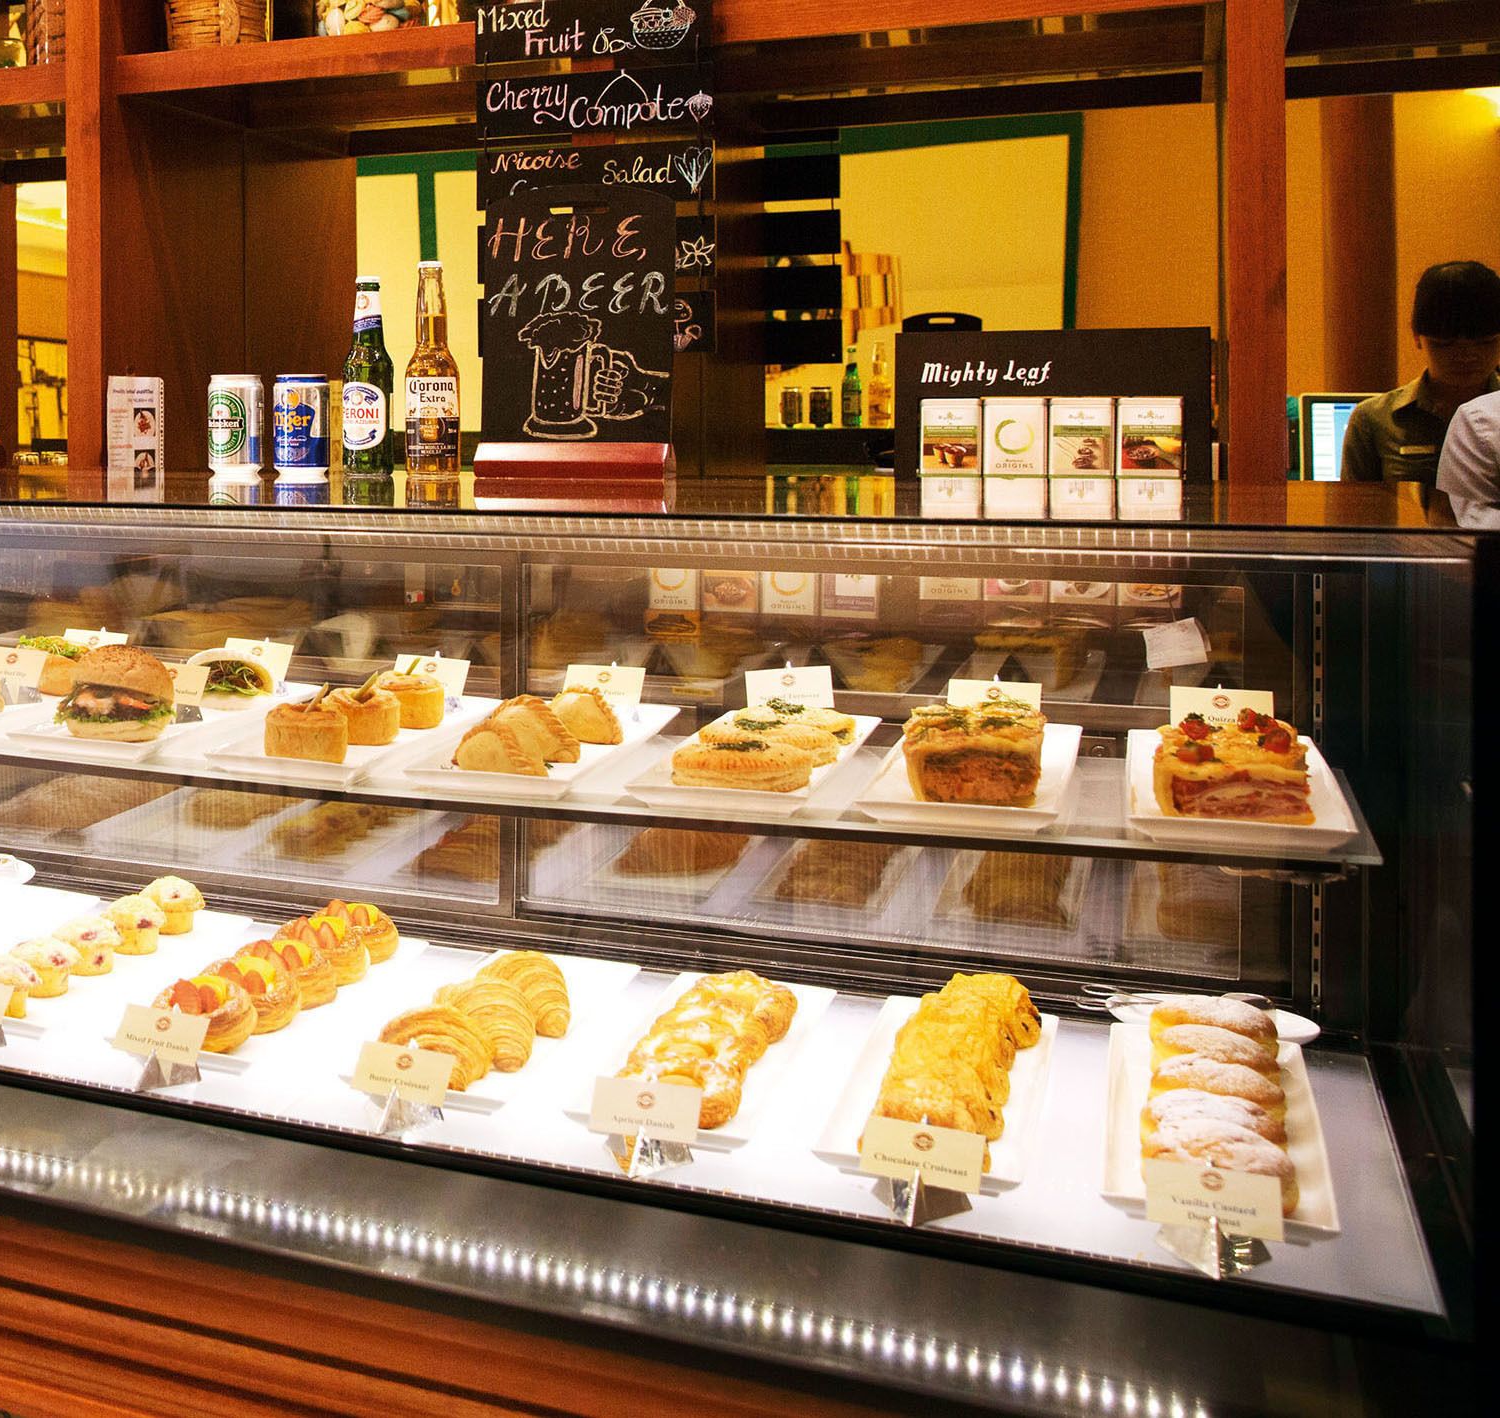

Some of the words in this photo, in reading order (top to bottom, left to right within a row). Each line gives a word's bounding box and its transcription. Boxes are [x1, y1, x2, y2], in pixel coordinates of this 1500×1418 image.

[476, 0, 550, 35] Mixed
[523, 19, 586, 57] Fruit
[485, 79, 568, 125] Cherry
[568, 83, 684, 129] Compote
[602, 154, 676, 185] Salad
[409, 379, 455, 395] Corona
[920, 361, 999, 388] Mighty
[1002, 359, 1053, 385] Leaf
[420, 392, 446, 403] Extra
[274, 411, 311, 433] Tiger
[873, 1152, 920, 1168] Chocolate
[922, 1161, 968, 1177] Croissant
[1171, 1194, 1210, 1208] Vanilla
[1212, 1202, 1257, 1216] Custard
